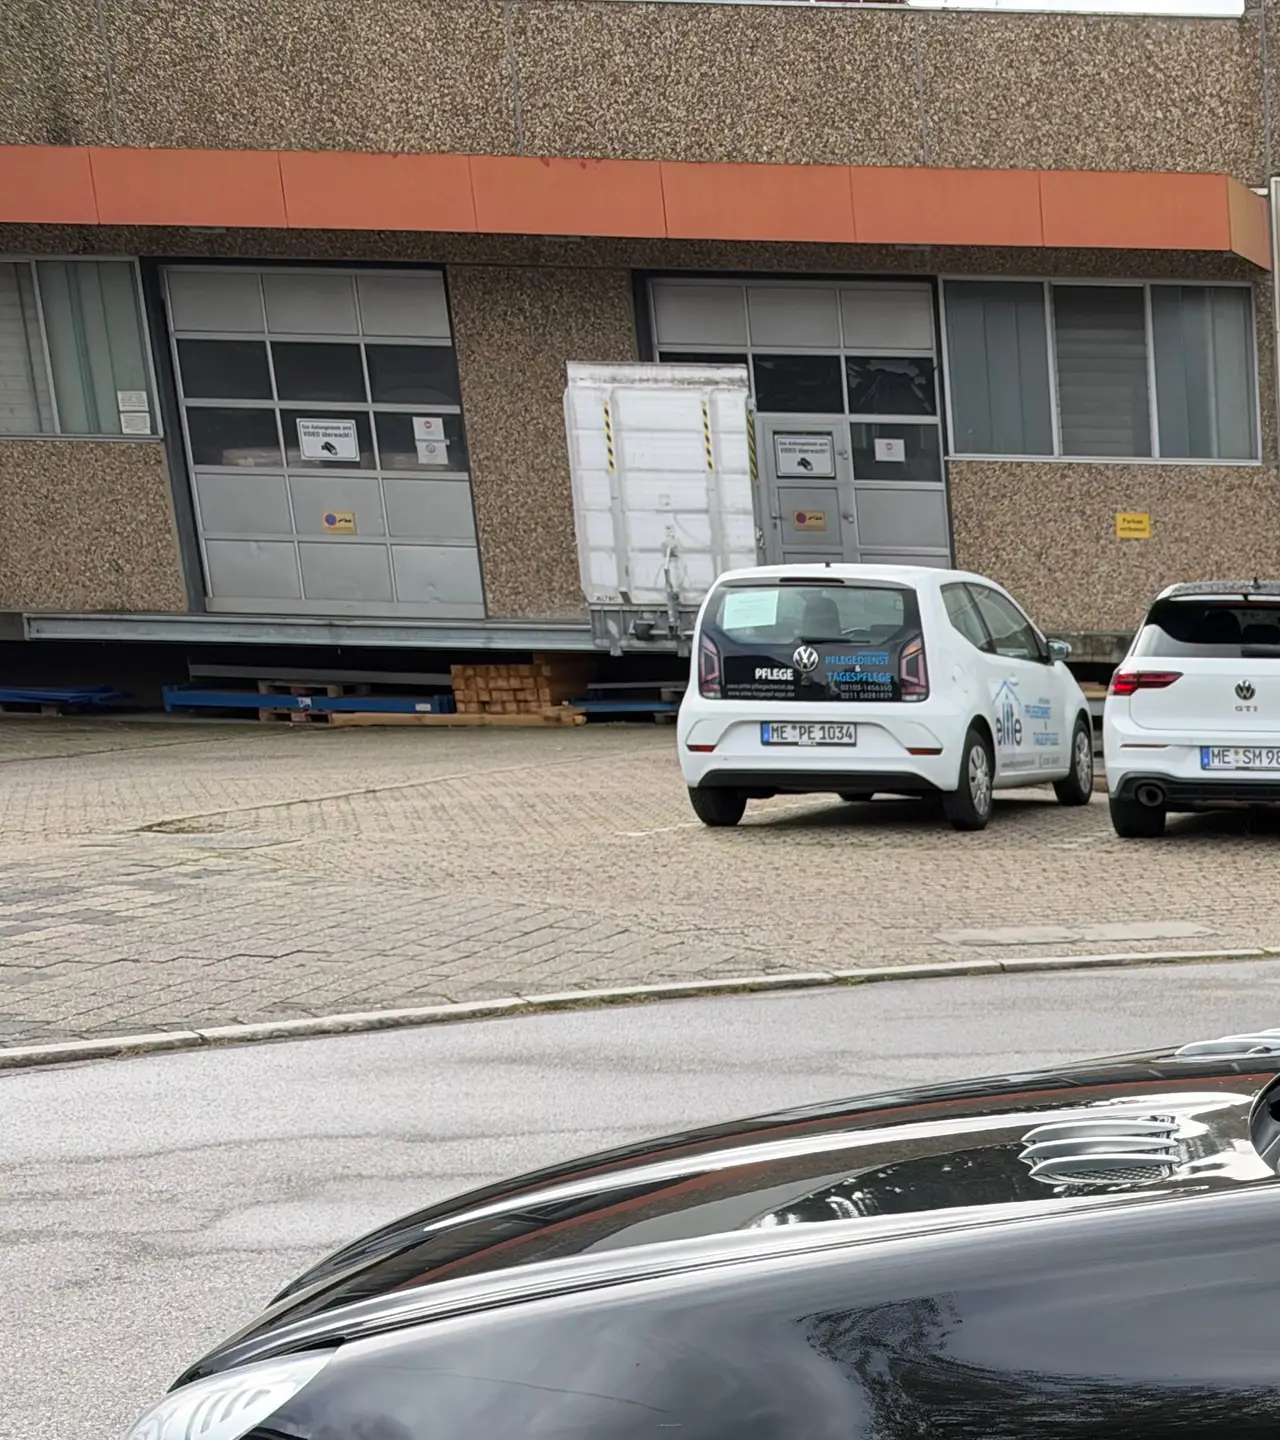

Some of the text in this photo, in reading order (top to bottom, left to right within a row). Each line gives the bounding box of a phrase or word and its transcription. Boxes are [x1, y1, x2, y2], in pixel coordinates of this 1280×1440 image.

[825, 655, 889, 665] PFLEGEDIENST
[755, 668, 794, 681] PFLEGE
[827, 671, 891, 682] TAGESPFLEGE
[771, 725, 853, 740] ME PE 1034
[1211, 749, 1231, 764] ME
[1243, 749, 1262, 764] SM
